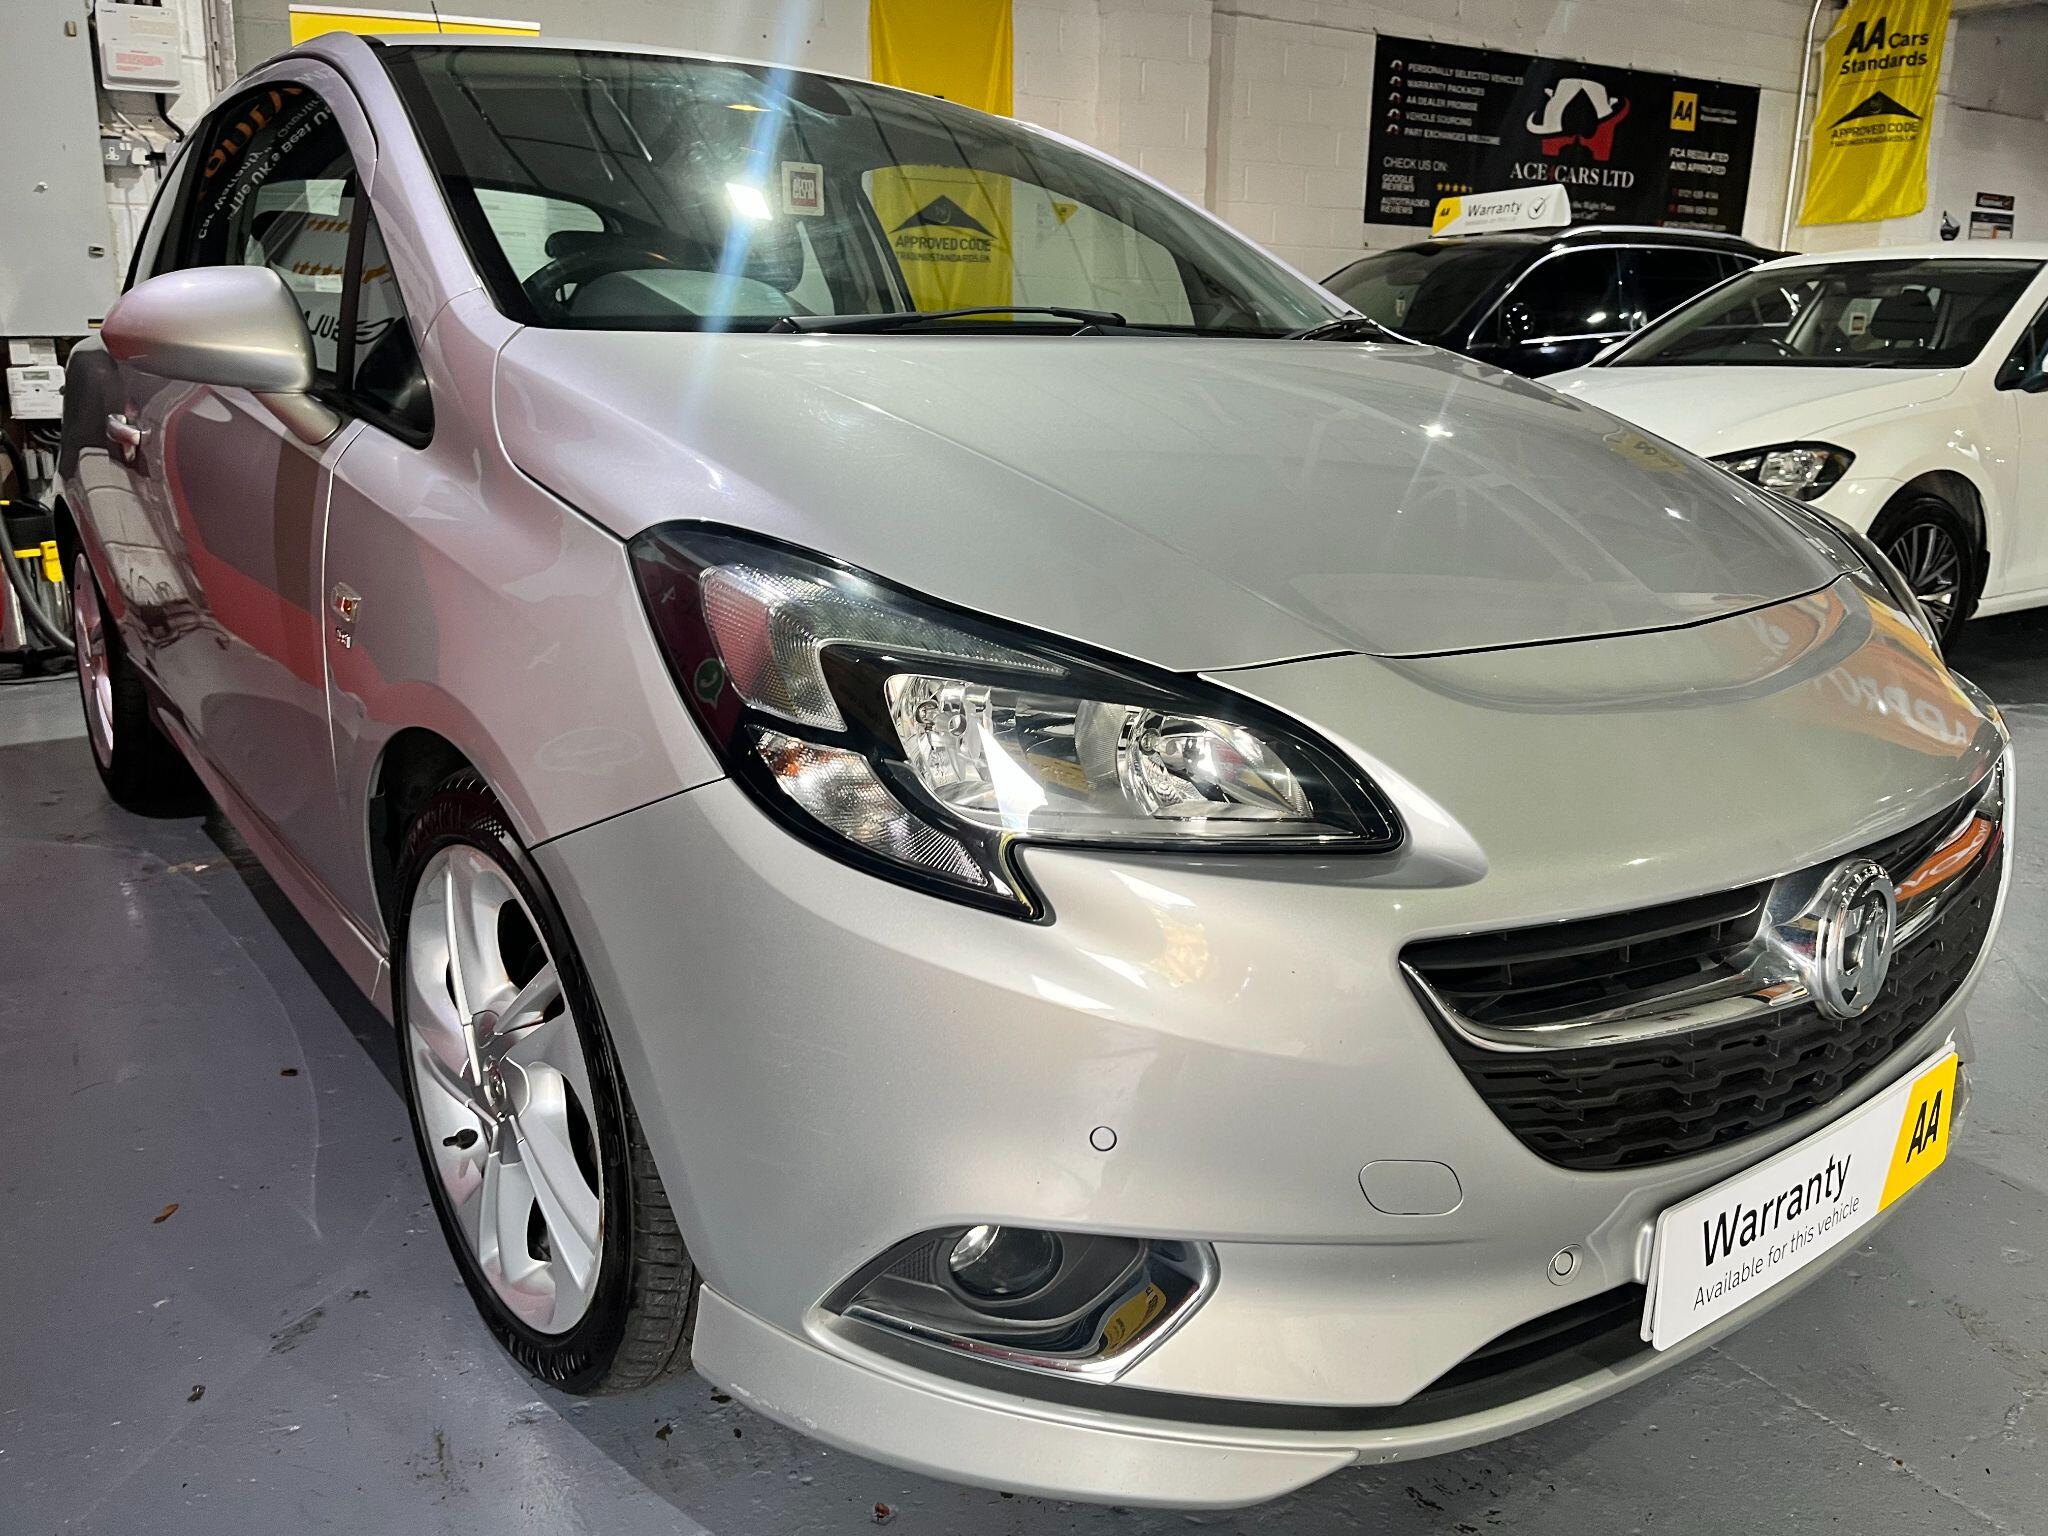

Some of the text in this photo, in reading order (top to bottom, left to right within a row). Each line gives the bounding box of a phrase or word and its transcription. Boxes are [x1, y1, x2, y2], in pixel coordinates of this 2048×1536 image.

[1843, 17, 1929, 56] AA Cars
[1840, 51, 1928, 75] Standards
[1673, 100, 1693, 122] AA
[1887, 122, 1920, 133] CODE
[1383, 156, 1416, 170] CHECK
[1417, 160, 1432, 171] US
[1510, 161, 1634, 188] ACE CARS LTD
[1467, 201, 1522, 217] Warranty
[895, 235, 992, 252] APPROVED CODE
[1905, 1088, 1943, 1165] AA
[1702, 1153, 1852, 1267] Warranty
[1693, 1195, 1860, 1311] Available for this vehicle
